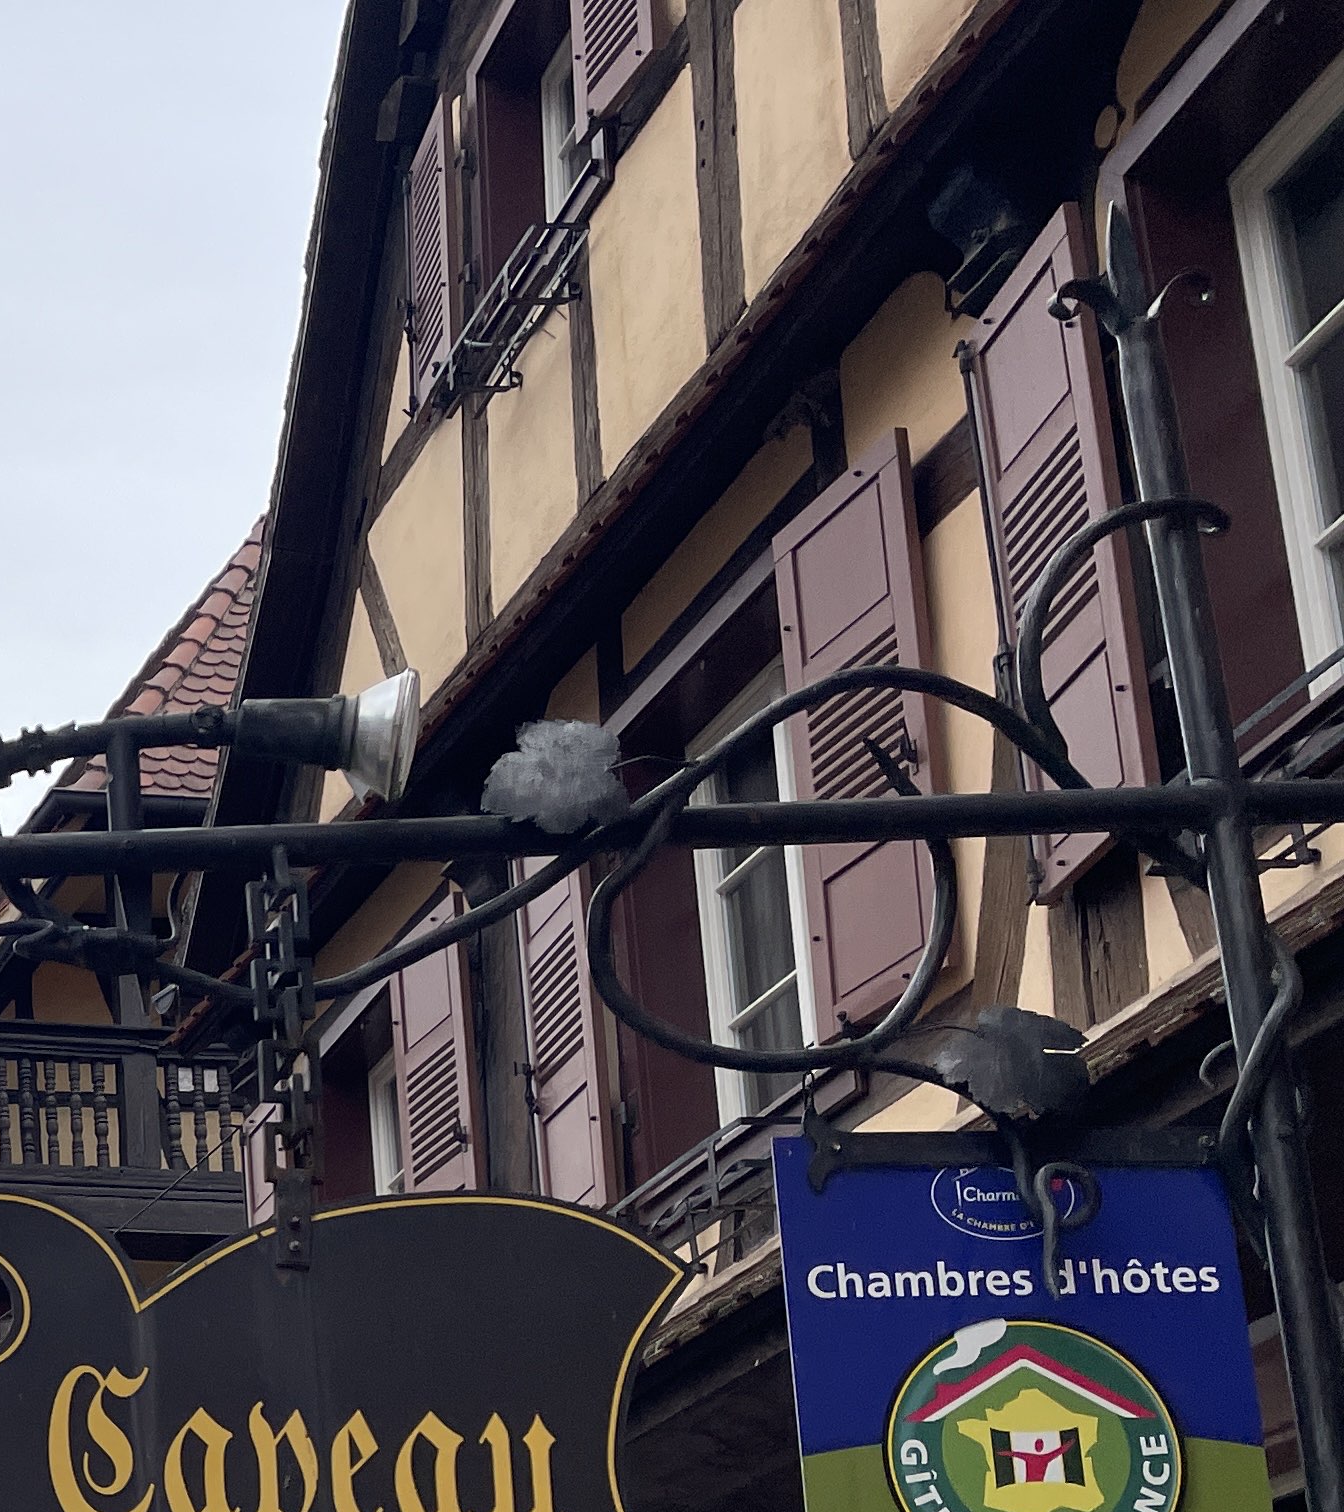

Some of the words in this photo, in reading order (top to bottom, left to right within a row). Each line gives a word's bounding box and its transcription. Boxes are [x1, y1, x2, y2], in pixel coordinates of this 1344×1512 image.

[966, 1216, 1016, 1231] CHAMBRE
[806, 1261, 1034, 1298] Chambres
[1057, 1258, 1221, 1296] d'hôtes
